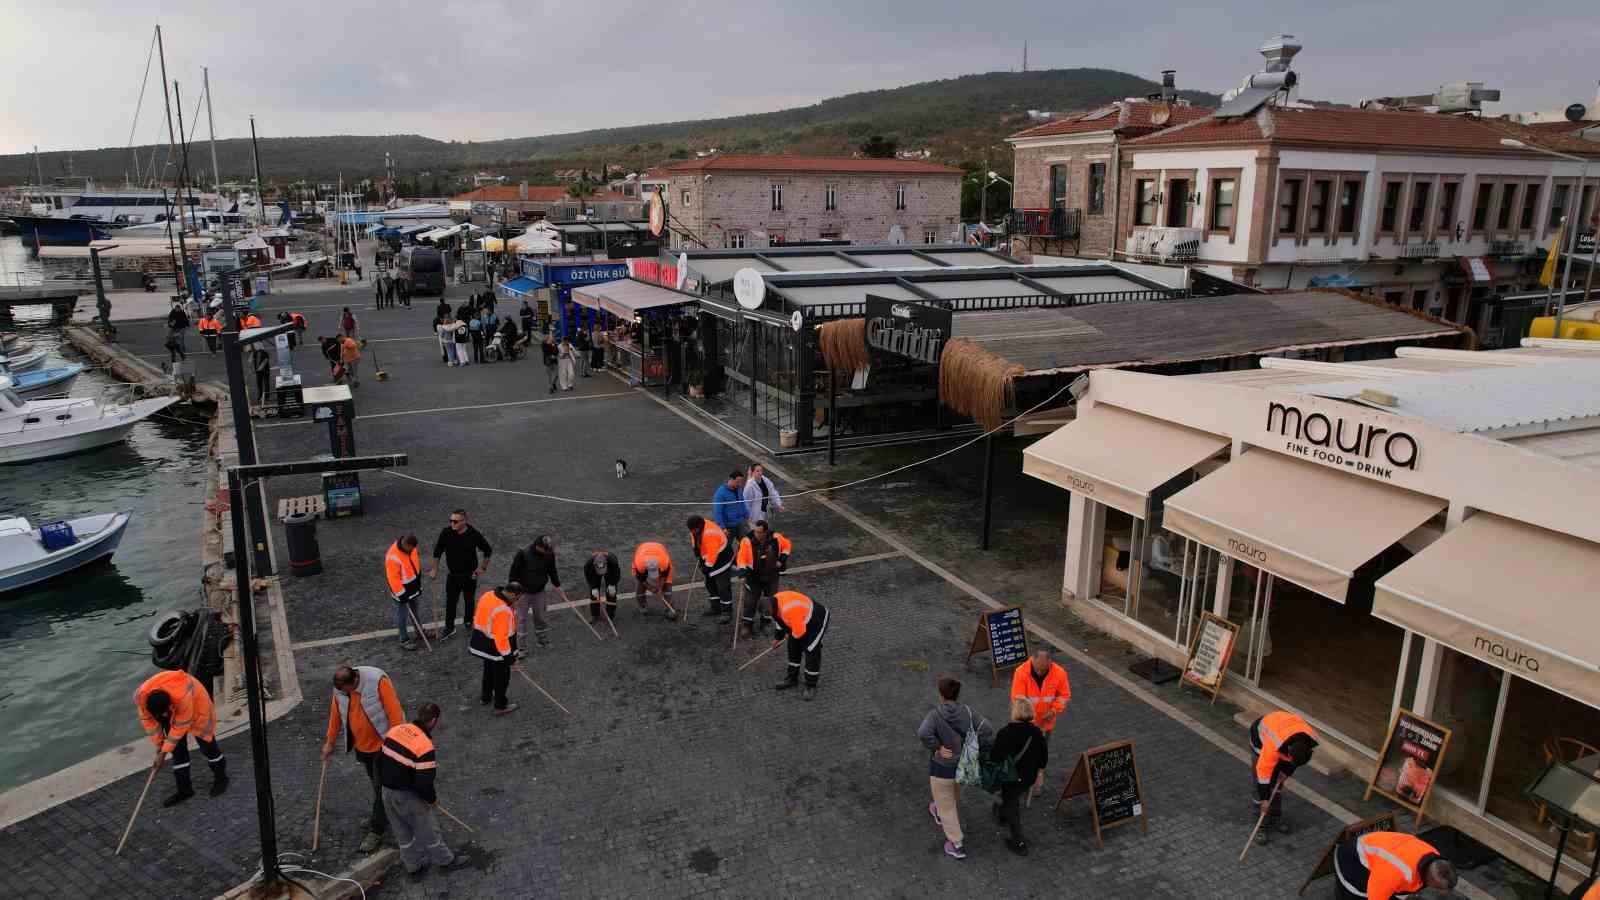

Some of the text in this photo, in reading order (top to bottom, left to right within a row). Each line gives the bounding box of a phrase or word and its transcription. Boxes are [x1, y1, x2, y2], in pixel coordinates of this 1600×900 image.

[571, 267, 609, 281] ÖZTÜRK
[1266, 402, 1418, 470] maura
[1286, 442, 1393, 479] FINE FOOD DRINK
[1066, 475, 1096, 493] maura
[1227, 537, 1268, 563] maura
[1473, 636, 1540, 673] maura
